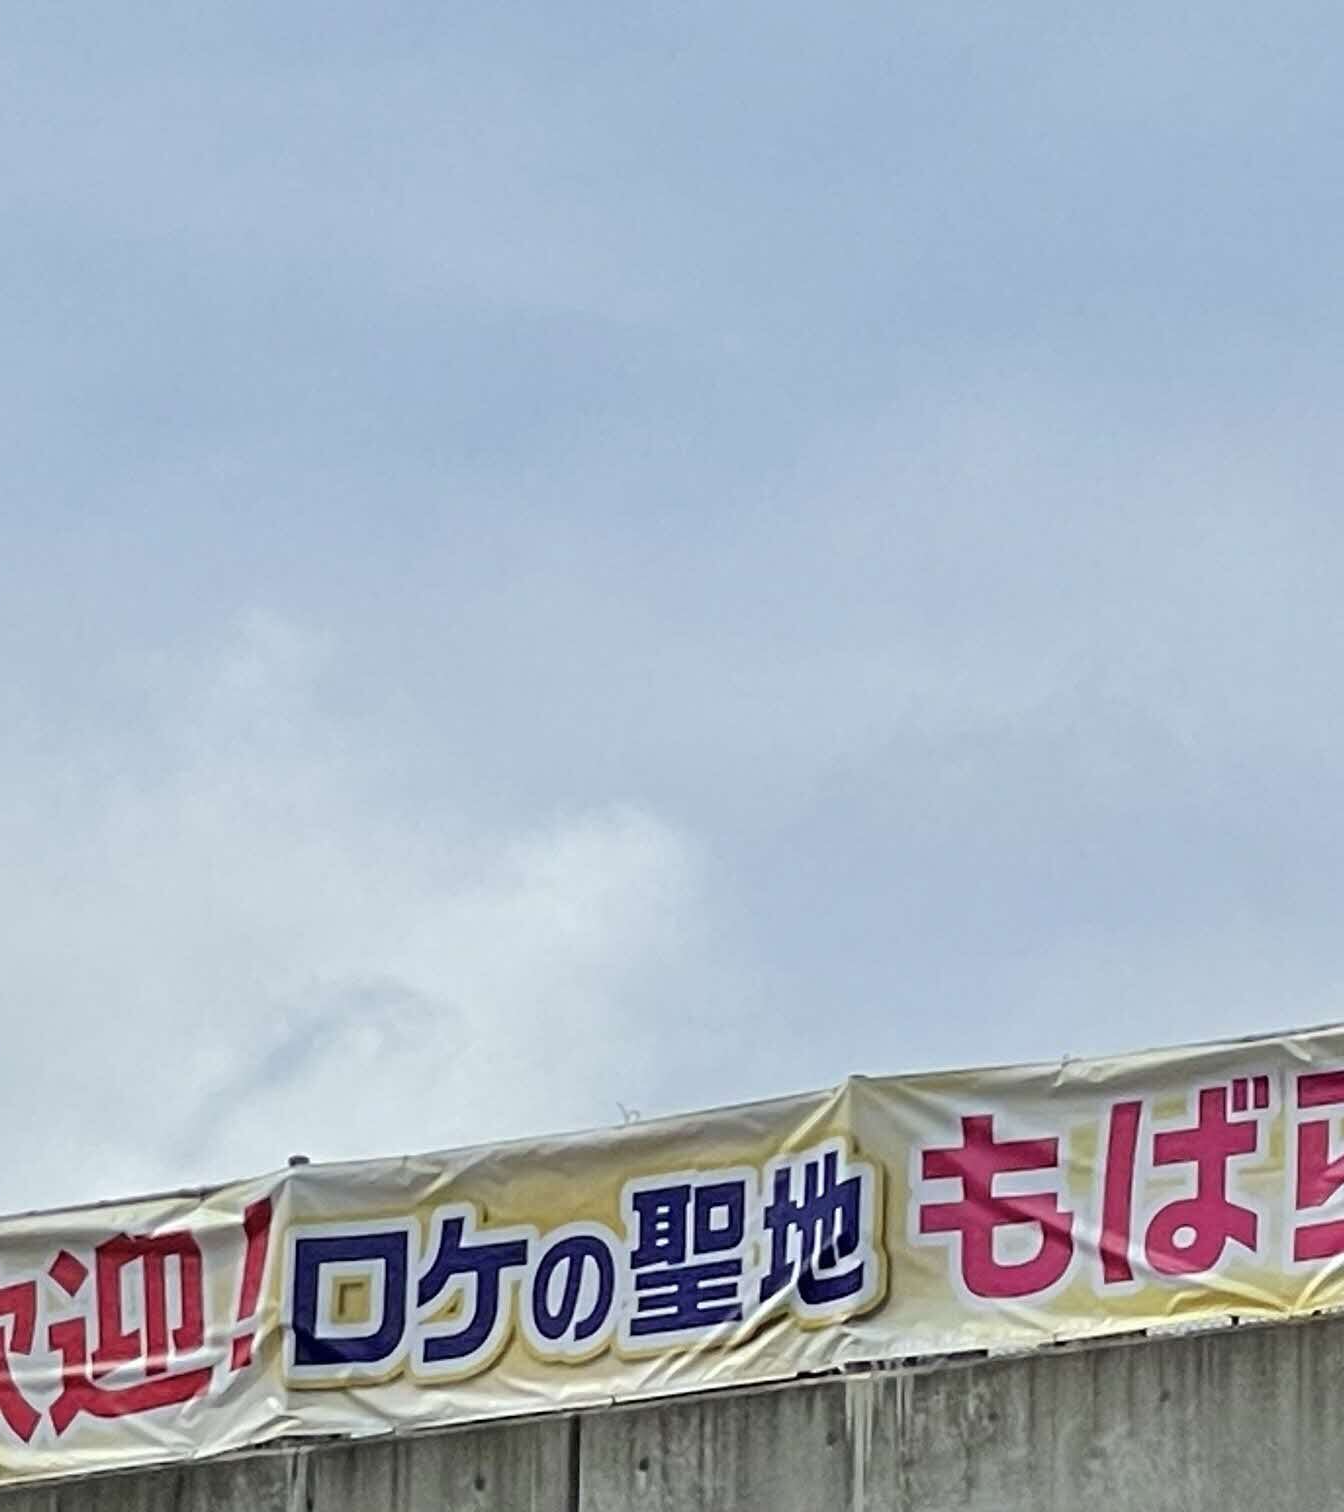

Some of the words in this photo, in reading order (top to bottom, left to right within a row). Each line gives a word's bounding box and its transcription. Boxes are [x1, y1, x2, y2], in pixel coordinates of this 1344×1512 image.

[293, 1151, 863, 1366] ロケの聖地
